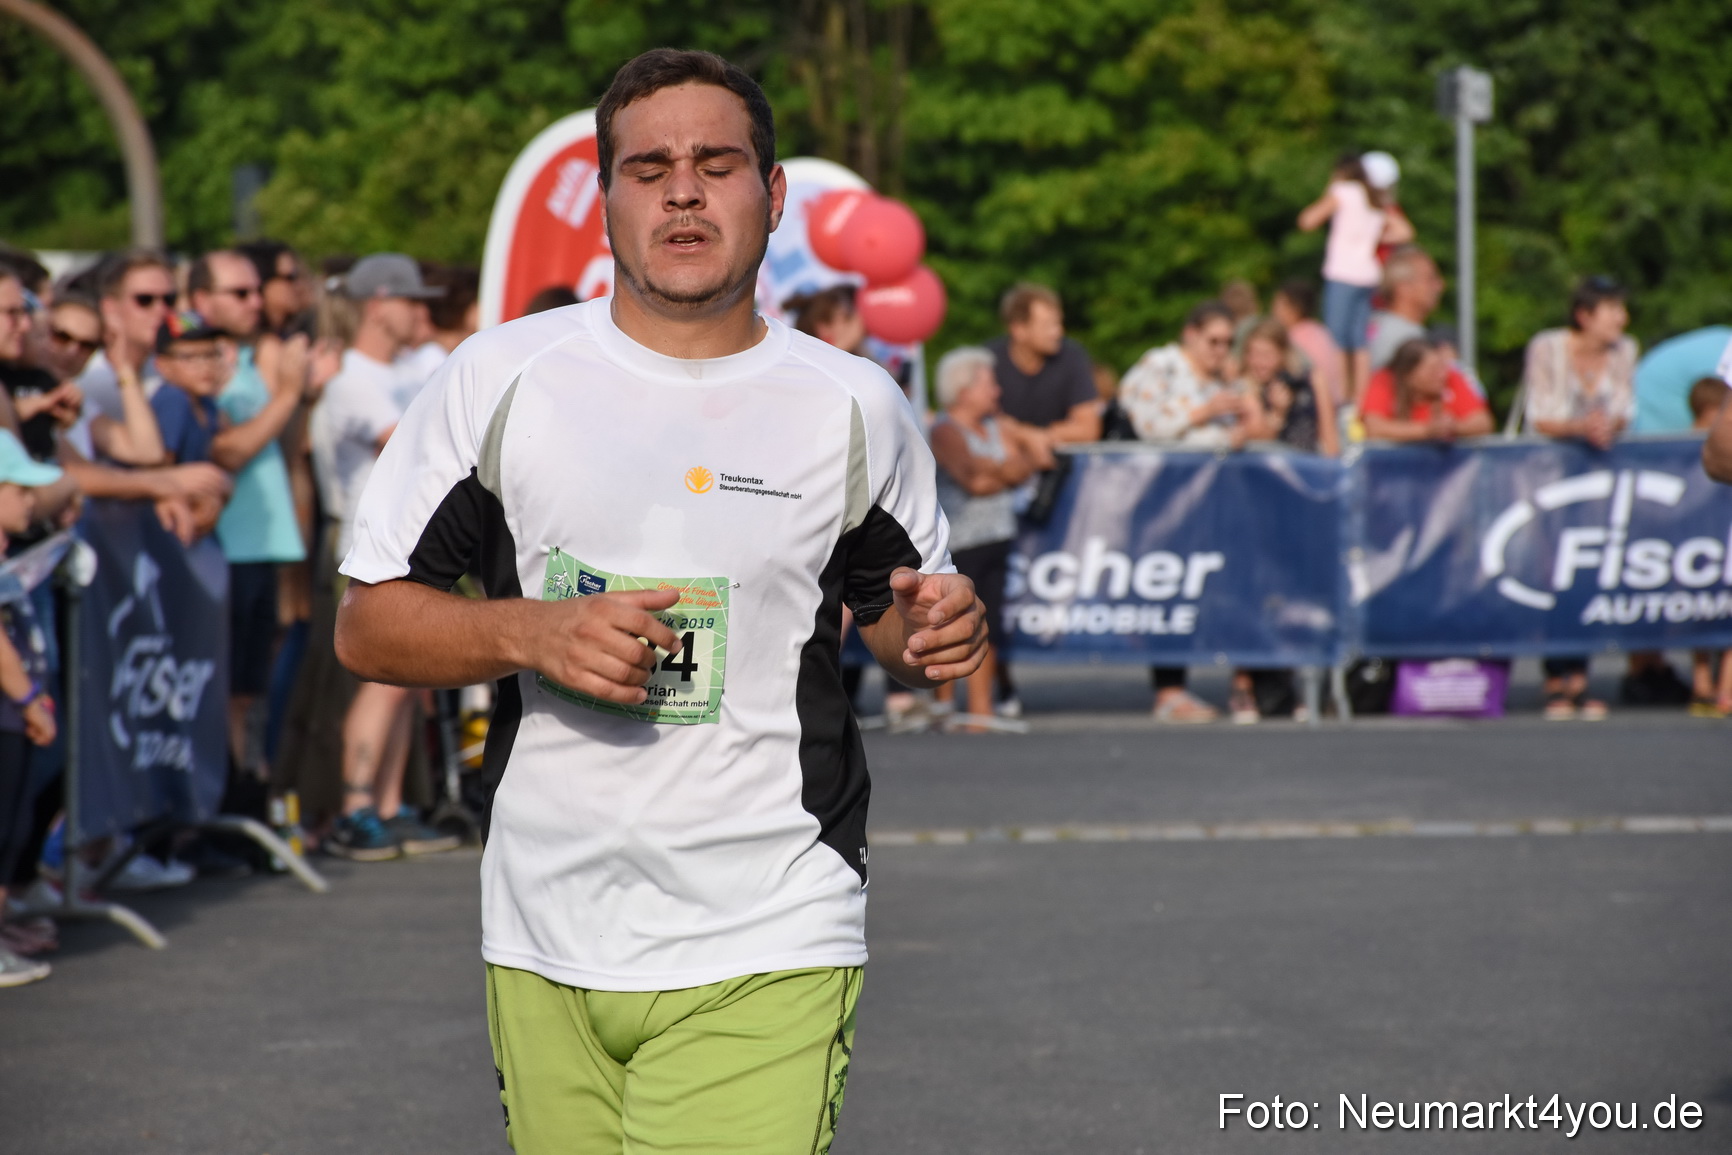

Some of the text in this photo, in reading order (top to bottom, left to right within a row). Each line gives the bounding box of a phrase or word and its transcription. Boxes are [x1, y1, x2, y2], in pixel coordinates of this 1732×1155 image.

[719, 473, 764, 486] Treukontax
[719, 484, 790, 499] Steuerberatungsgesellschaft
[1553, 526, 1732, 590] Fisc
[679, 617, 715, 629] 2019
